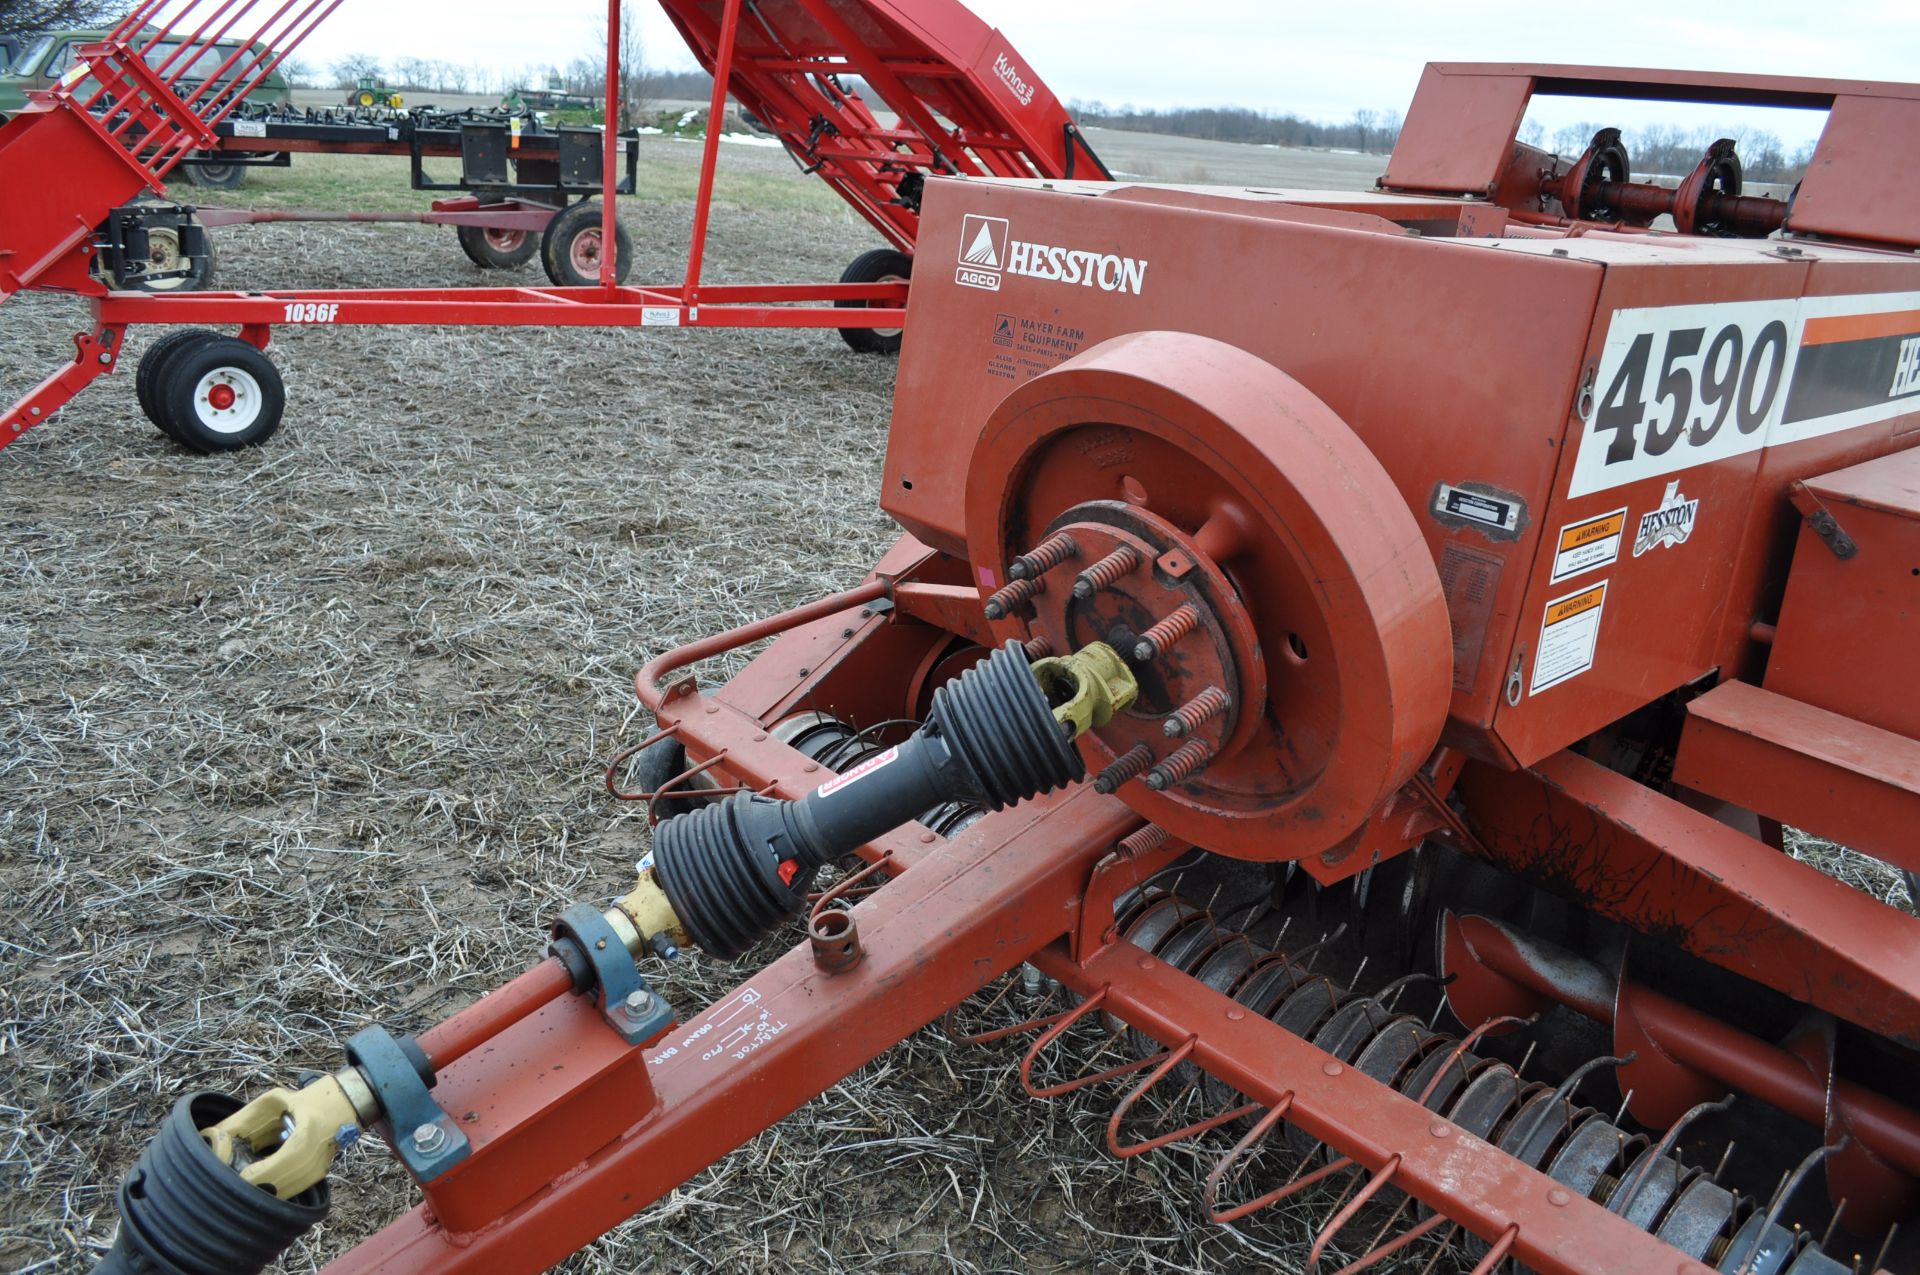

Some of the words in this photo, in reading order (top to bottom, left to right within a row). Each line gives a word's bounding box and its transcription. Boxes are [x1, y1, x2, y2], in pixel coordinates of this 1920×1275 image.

[995, 52, 1027, 95] Kuhns
[1007, 240, 1148, 295] HESSTON
[960, 271, 996, 287] AGCO
[284, 303, 339, 323] 1036F
[1020, 319, 1054, 334] MAYER
[1056, 326, 1085, 341] FARM
[1022, 332, 1079, 352] EQUIPMENT
[1594, 319, 1788, 467] 4590
[1640, 501, 1697, 538] HESSTON
[1581, 522, 1610, 540] WARNING
[1563, 594, 1593, 614] WARNING
[682, 1023, 713, 1048] DRAW
[731, 1020, 788, 1060] TRACTOR
[647, 1047, 679, 1065] BAR
[702, 1044, 724, 1061] PTO
